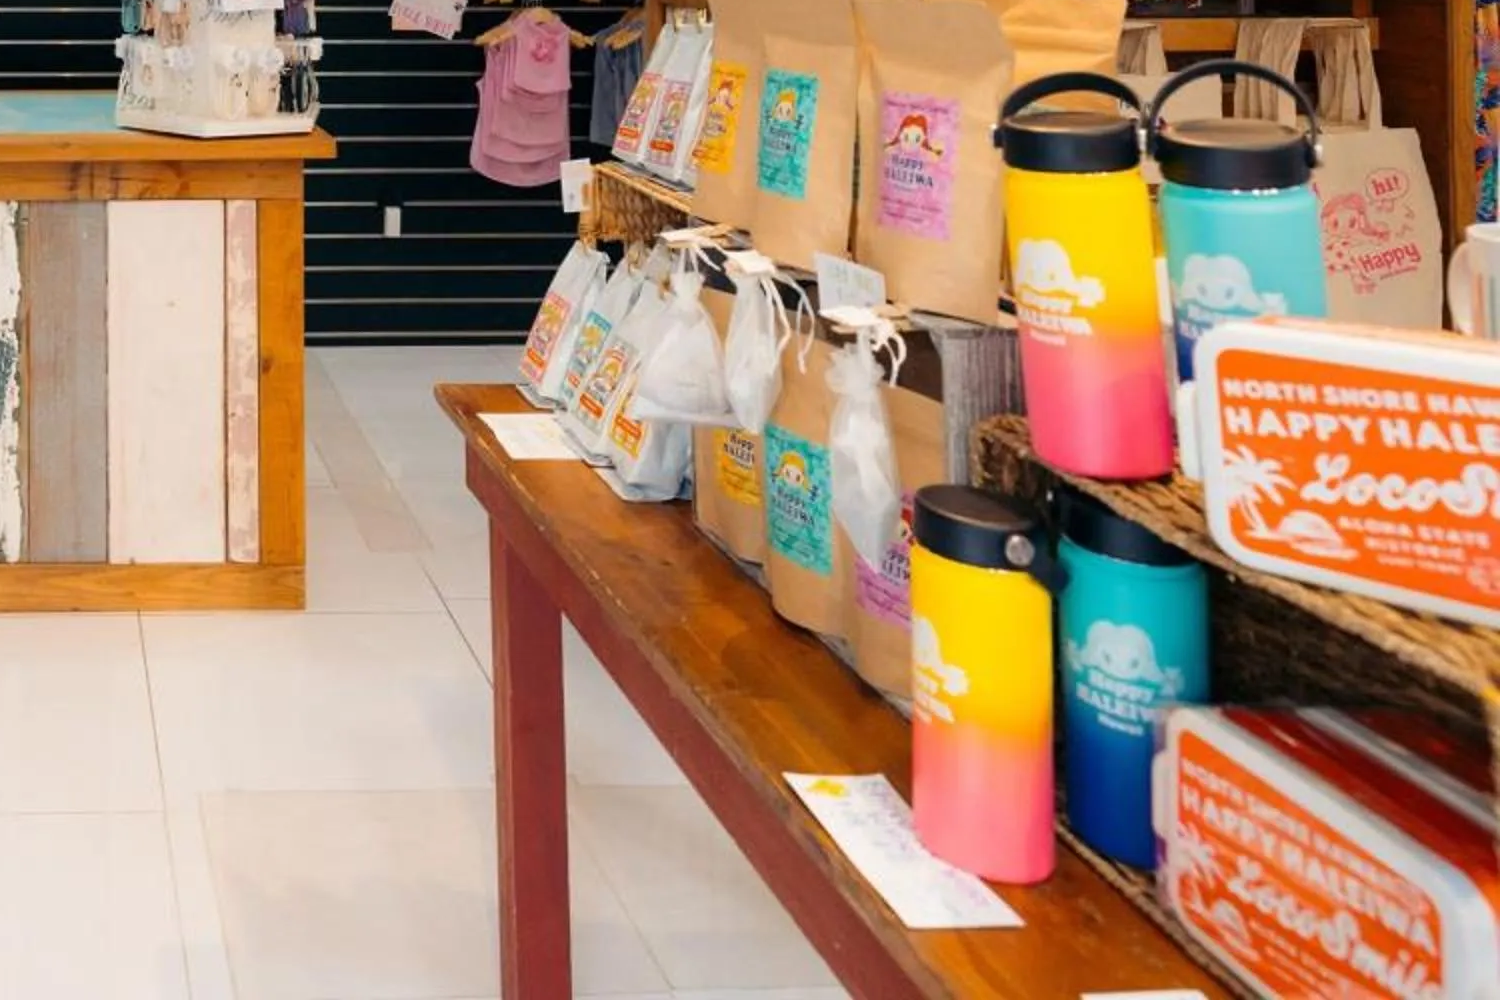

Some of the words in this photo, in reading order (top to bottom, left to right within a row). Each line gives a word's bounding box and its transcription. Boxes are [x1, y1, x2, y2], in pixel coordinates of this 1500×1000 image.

[1359, 242, 1421, 273] Happy
[1222, 377, 1317, 404] NORTH
[1323, 384, 1421, 412] SHORE
[1224, 404, 1371, 445] HAPPY
[1075, 682, 1158, 723] HALEIW
